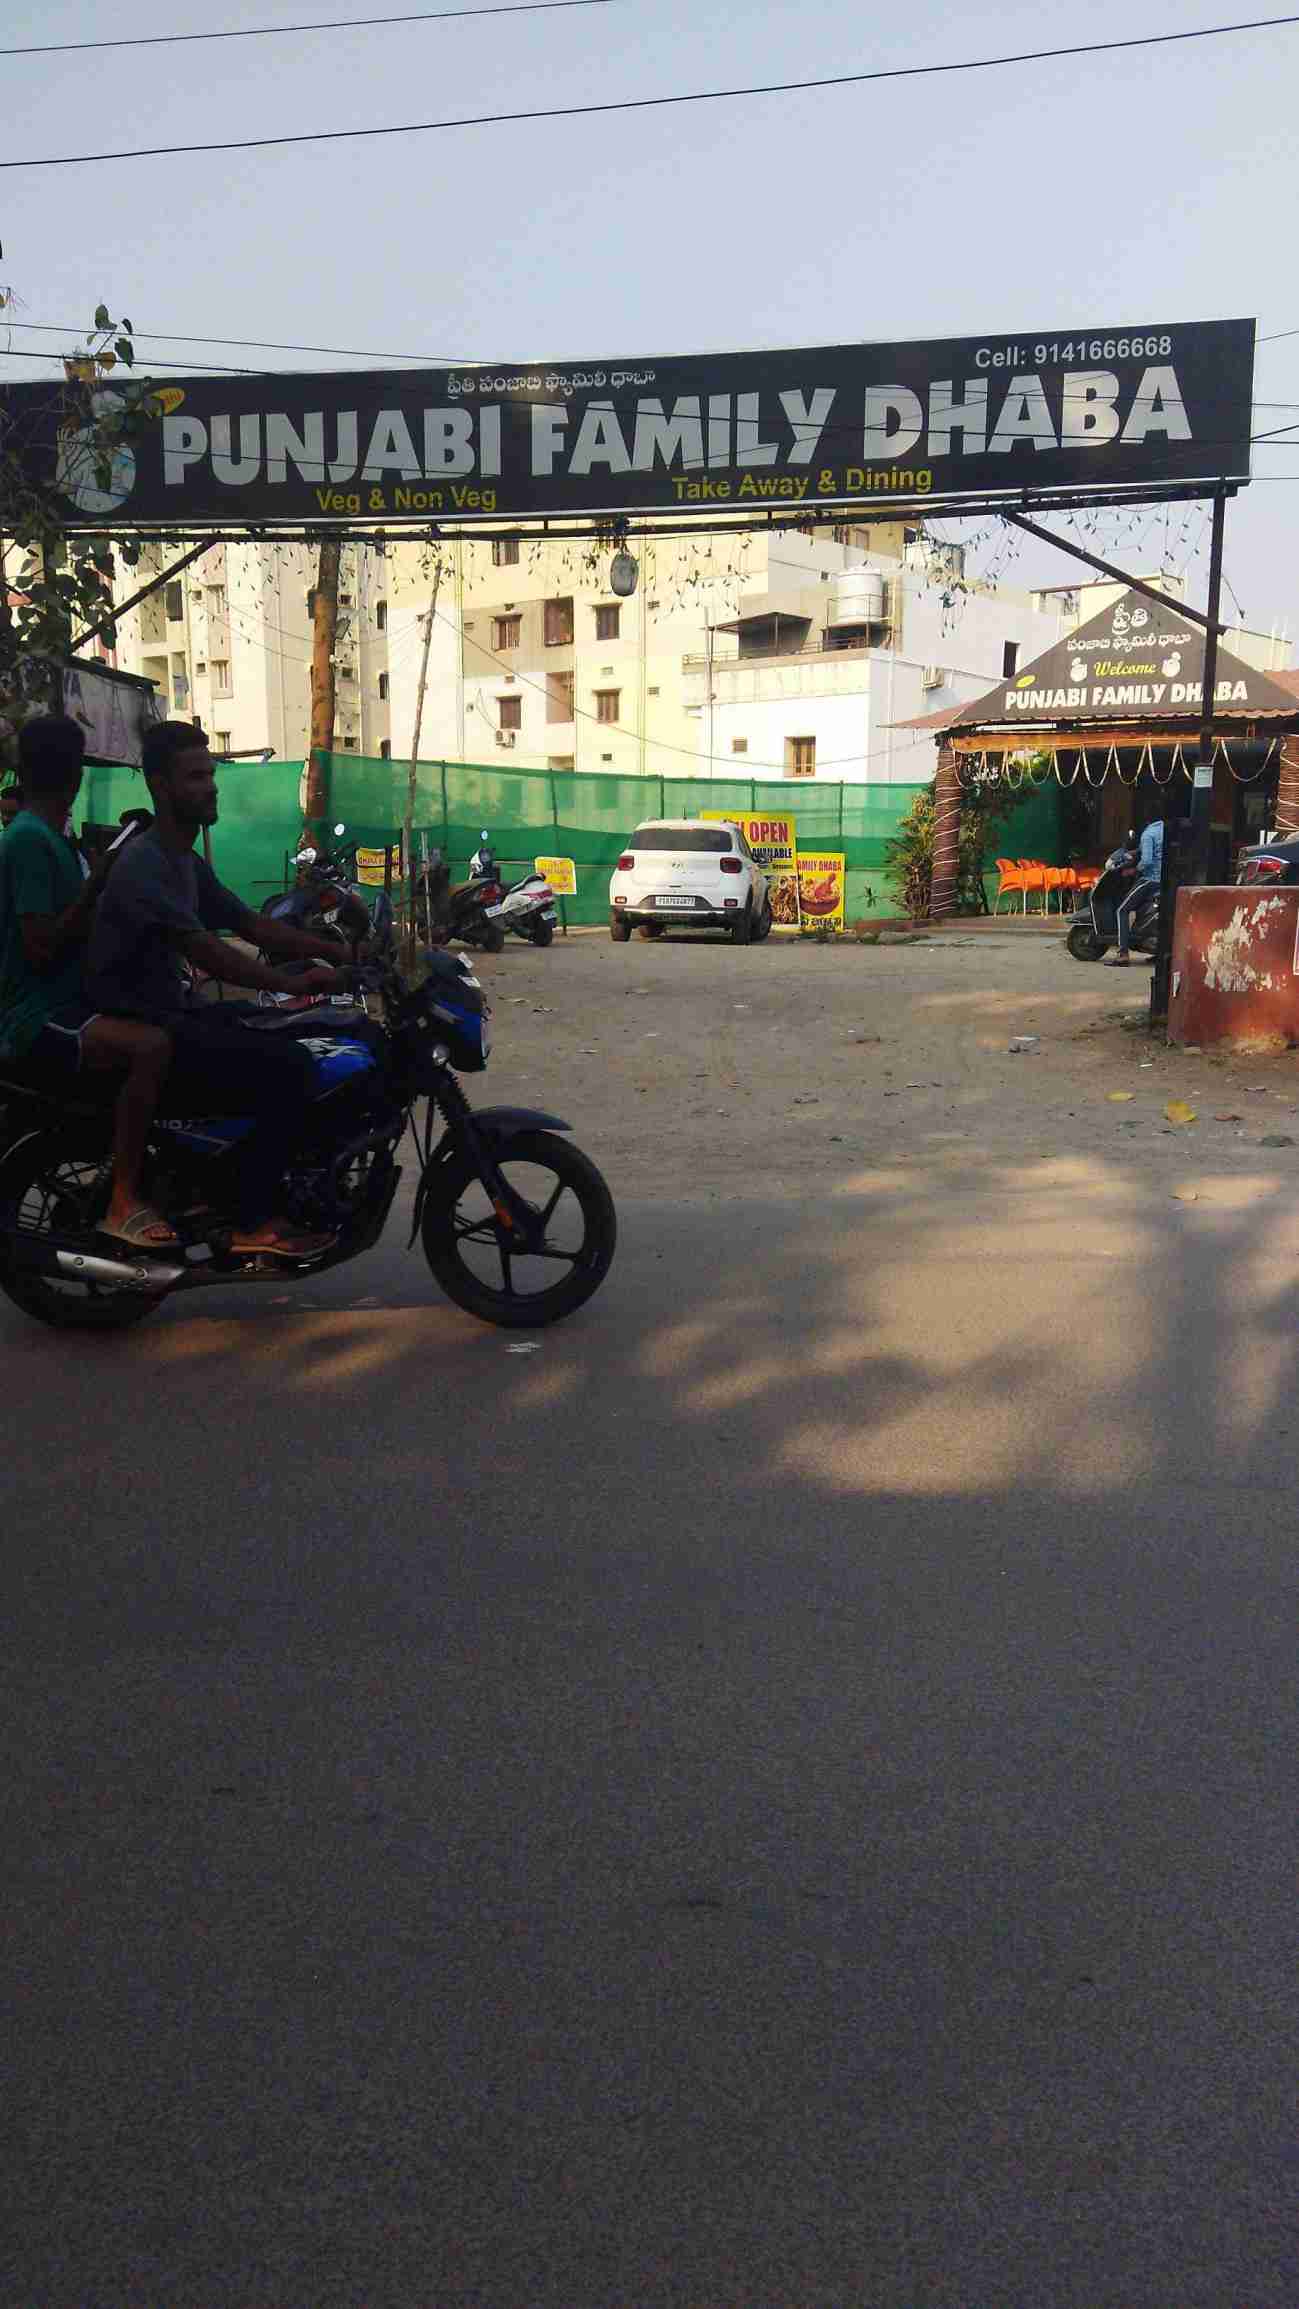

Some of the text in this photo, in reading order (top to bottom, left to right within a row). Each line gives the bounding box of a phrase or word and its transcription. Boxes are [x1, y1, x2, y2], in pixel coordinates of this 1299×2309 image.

[975, 335, 1172, 368] Cell: 9141666668
[163, 366, 1193, 486] PUNJABI FAMILY DHABA
[672, 465, 932, 500] Take Away & Dining
[316, 485, 497, 515] Veg & Non Veg
[1093, 660, 1158, 677] Welcome
[1005, 688, 1088, 710] PUNJABI
[1092, 684, 1167, 706] FAMILY
[750, 821, 789, 843] OPEN
